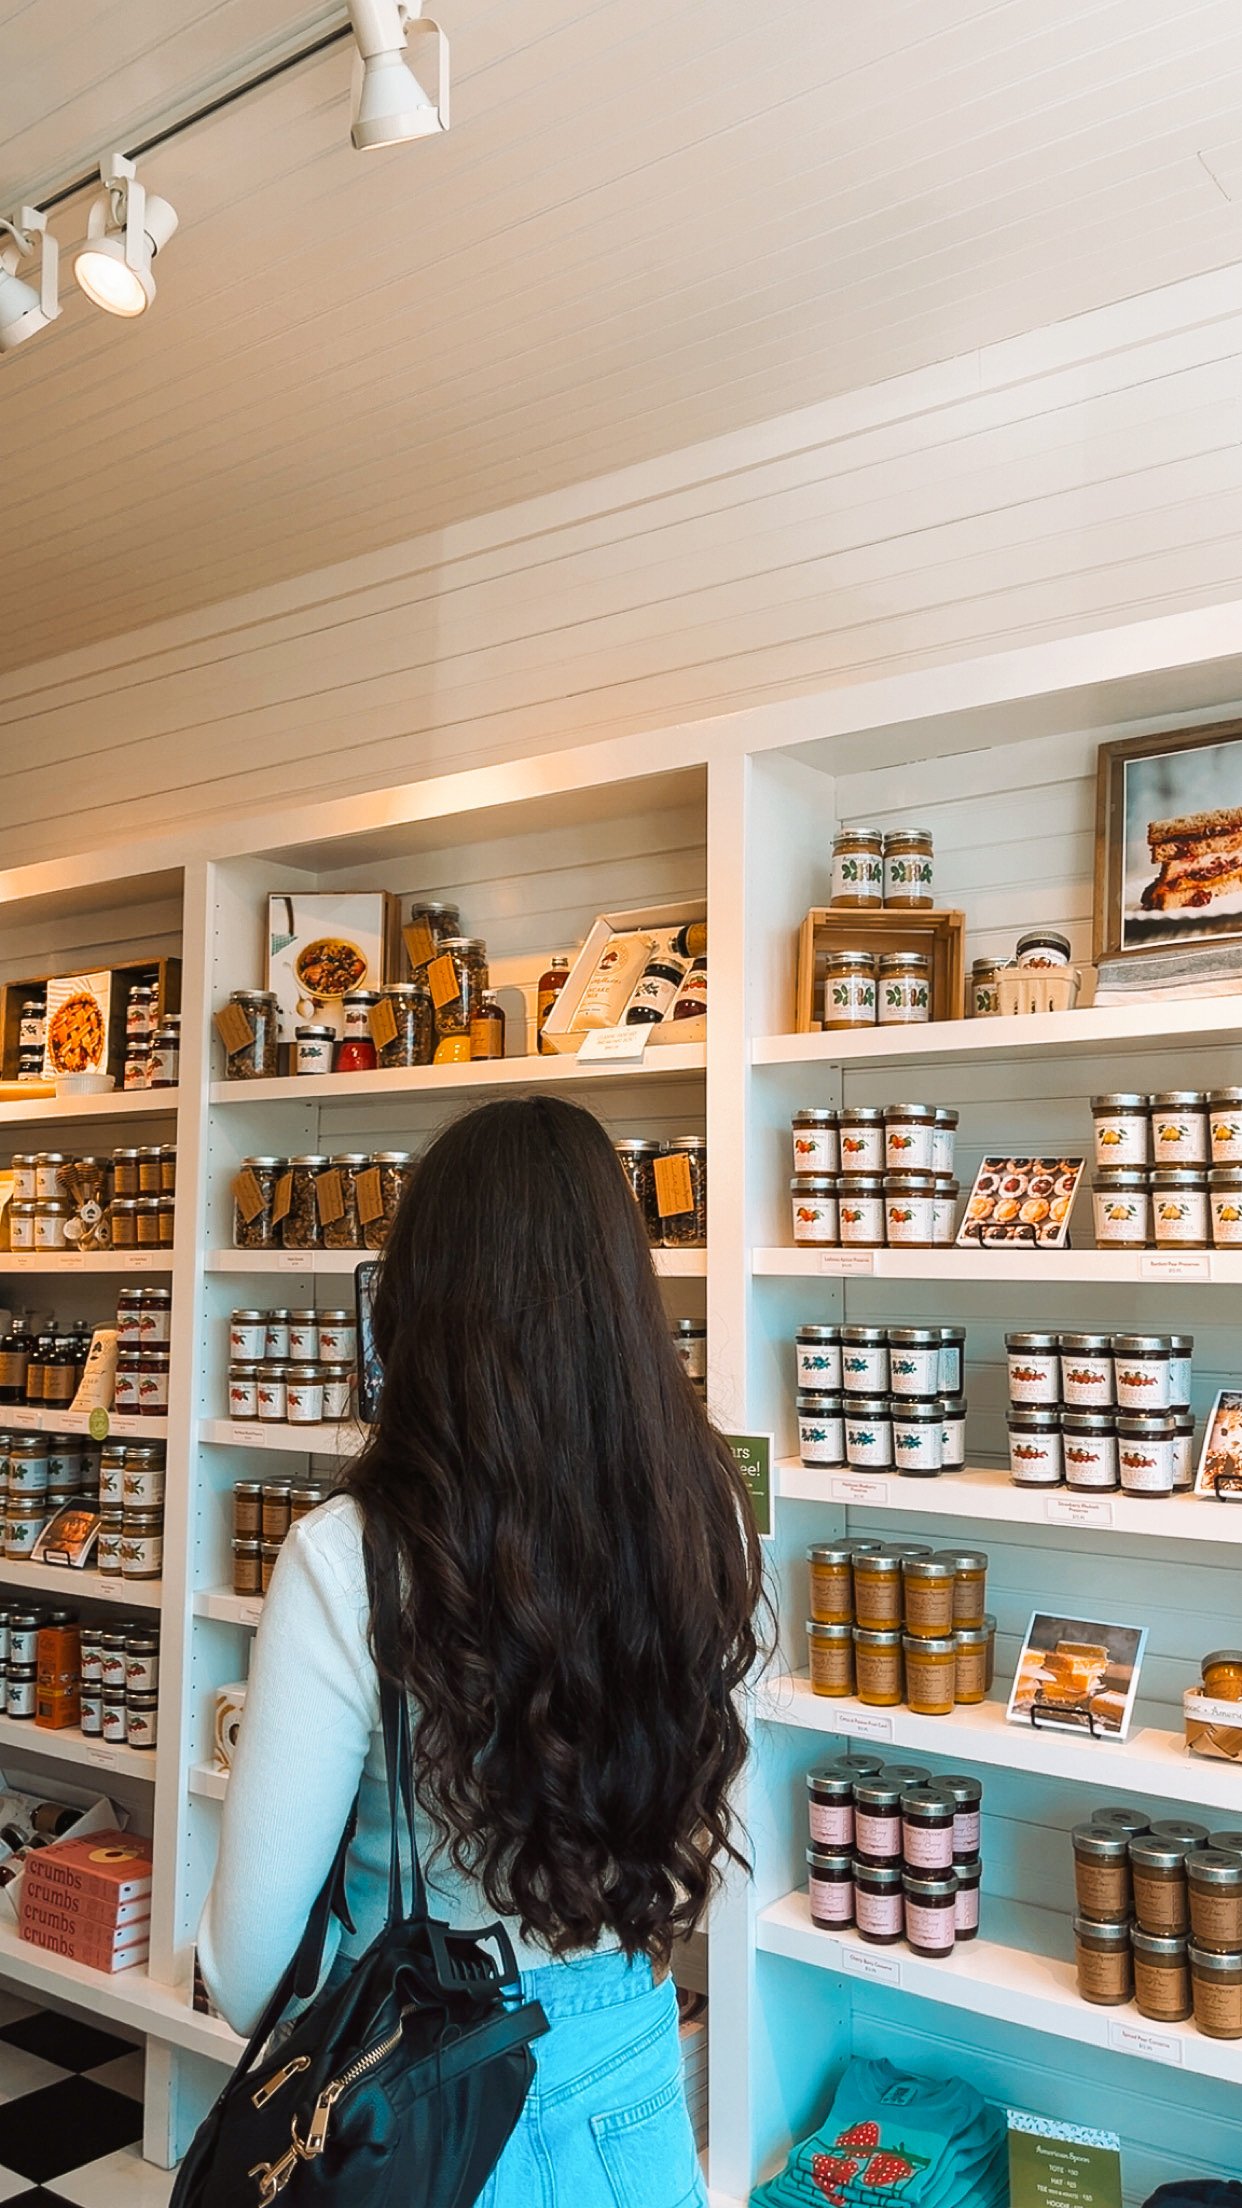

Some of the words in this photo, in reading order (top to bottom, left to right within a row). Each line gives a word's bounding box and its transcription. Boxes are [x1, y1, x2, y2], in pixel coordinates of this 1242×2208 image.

[29, 1859, 82, 1891] crumbs
[27, 1881, 80, 1913] crumbs
[24, 1903, 76, 1936] crumbs
[23, 1925, 75, 1958] crumbs
[1036, 2145, 1069, 2159] American
[1068, 2151, 1090, 2163] Spoon
[1049, 2164, 1065, 2174] TOTE
[1050, 2177, 1063, 2186] HAT
